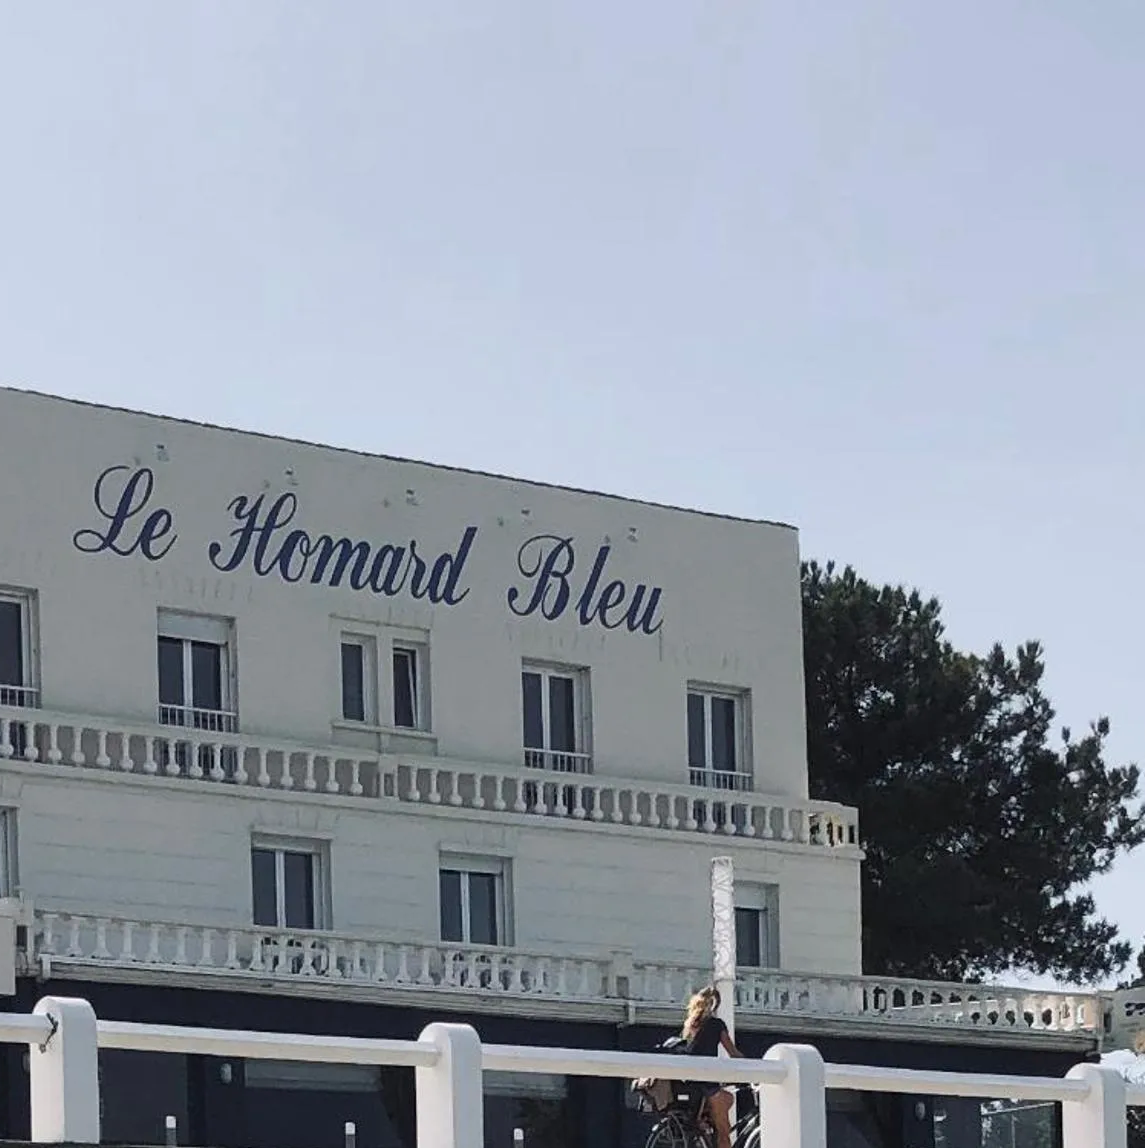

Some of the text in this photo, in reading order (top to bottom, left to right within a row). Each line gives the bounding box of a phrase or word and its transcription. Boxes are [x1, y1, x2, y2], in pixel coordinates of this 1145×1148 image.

[73, 466, 663, 634] Le Homard Bleu
